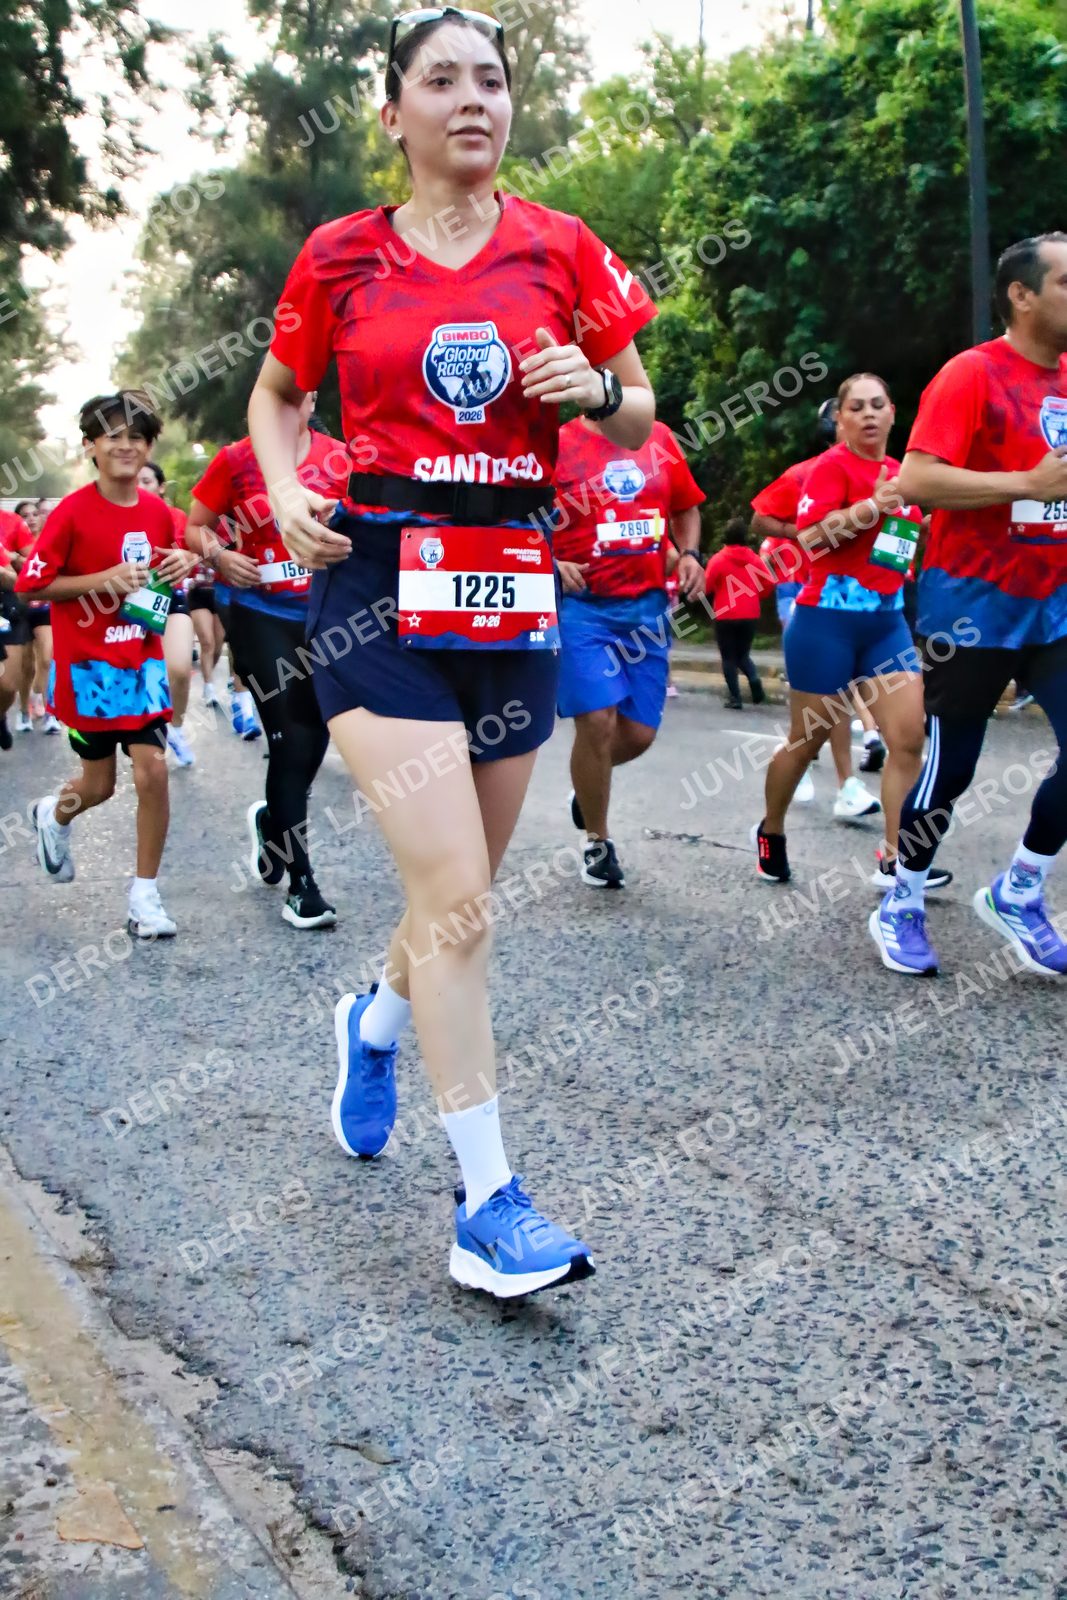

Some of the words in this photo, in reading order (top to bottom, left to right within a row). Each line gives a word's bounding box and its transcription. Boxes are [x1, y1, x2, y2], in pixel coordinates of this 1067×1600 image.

[442, 330, 489, 341] BIMBO
[444, 345, 490, 362] Global
[437, 362, 472, 377] Race
[458, 410, 482, 421] 2026
[620, 521, 650, 537] 2890
[452, 574, 515, 608] 1225
